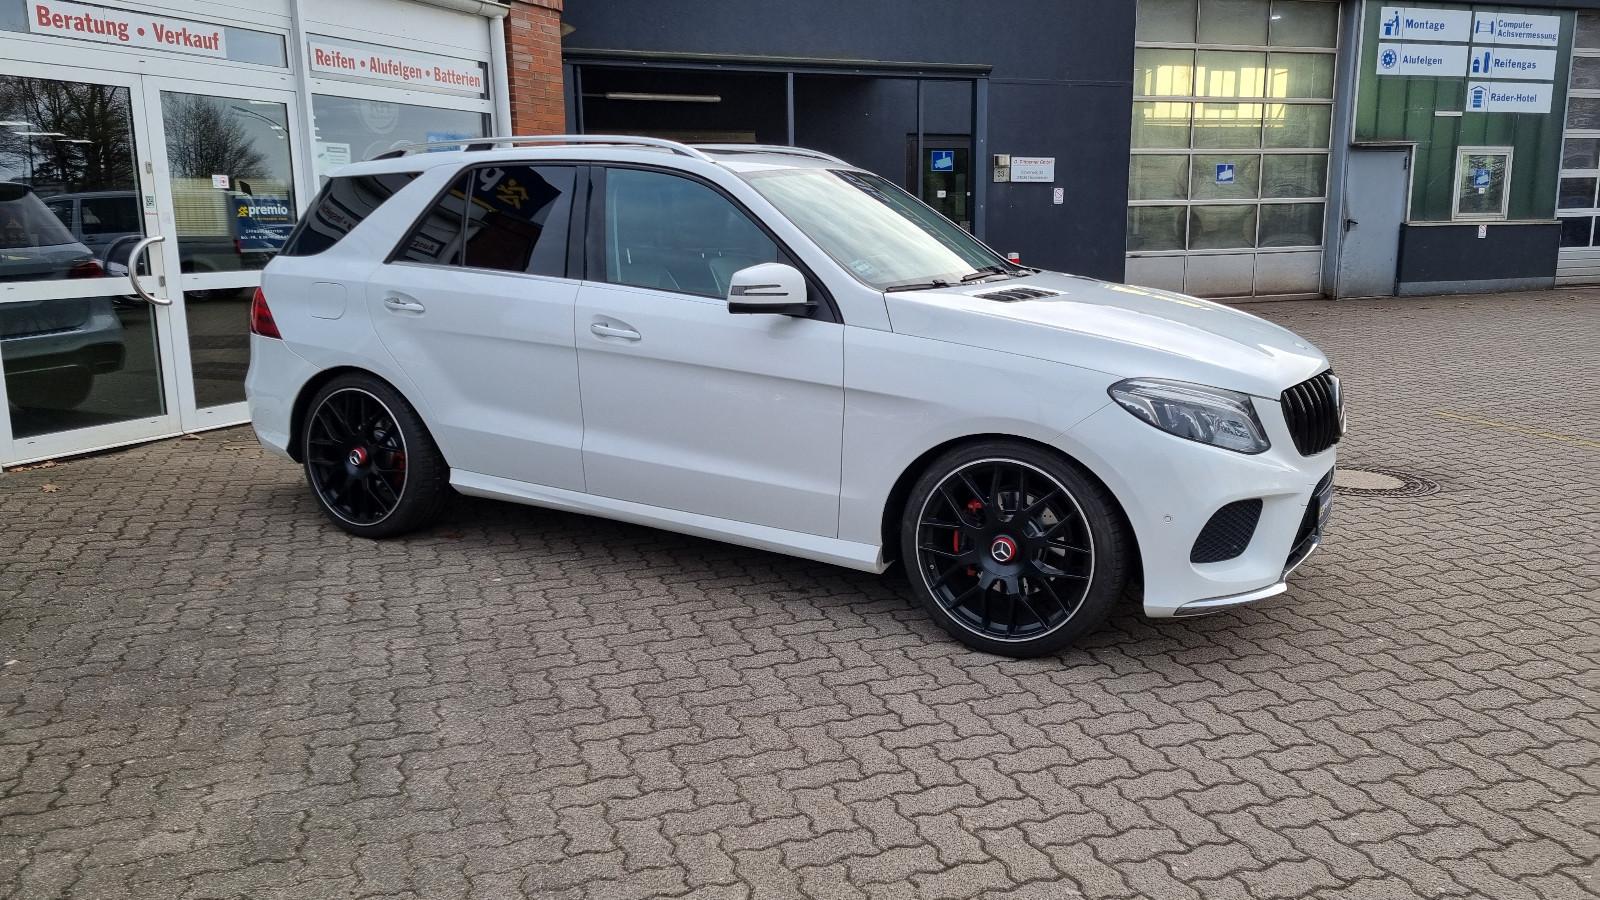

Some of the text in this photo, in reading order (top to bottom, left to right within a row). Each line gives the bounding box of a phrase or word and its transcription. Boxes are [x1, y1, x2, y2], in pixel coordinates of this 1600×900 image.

[36, 4, 220, 51] Beratung Verkauf
[1405, 18, 1445, 31] Montage
[1498, 19, 1533, 30] Computer
[1497, 30, 1557, 41] Achsvermessung
[1402, 55, 1443, 66] Alufelgen
[1493, 58, 1537, 70] Reifengas
[315, 48, 481, 88] Reifen Alufelgen Batterien
[1490, 92, 1537, 103] Räder-Hotel
[248, 204, 288, 217] premio
